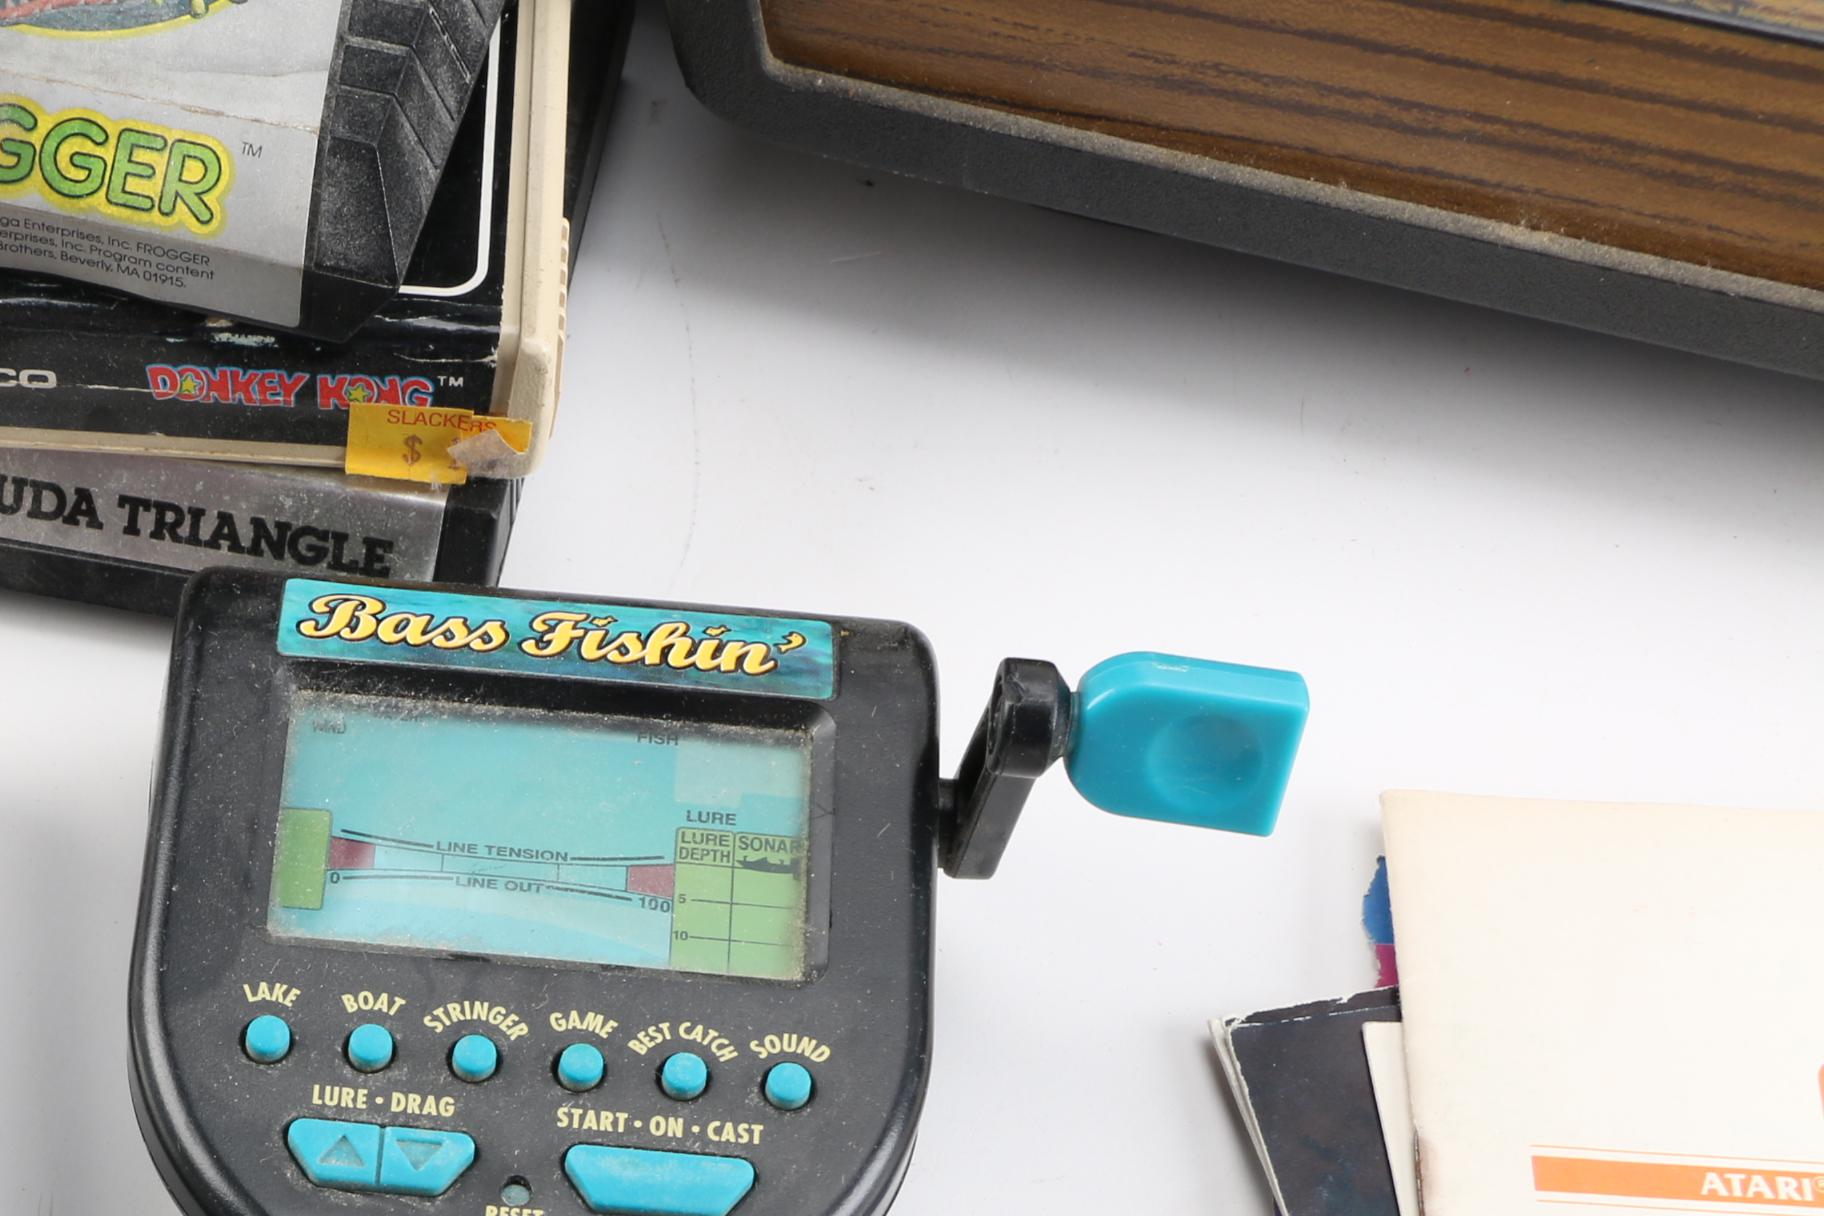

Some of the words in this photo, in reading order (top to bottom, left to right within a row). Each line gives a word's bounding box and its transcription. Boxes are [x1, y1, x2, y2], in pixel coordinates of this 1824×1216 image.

[89, 245, 152, 267] Program
[155, 261, 214, 280] content
[136, 243, 211, 266] FROGGER
[117, 263, 140, 278] MA
[145, 364, 310, 408] DONKEY
[318, 374, 435, 409] KONG
[387, 410, 497, 432] SLACKERS
[117, 494, 393, 577] TRIANGLE
[297, 594, 510, 653] Bass
[520, 611, 808, 677] Fishin'
[686, 810, 737, 826] LURE
[436, 841, 478, 855] LINE
[486, 845, 569, 862] TENSION
[681, 831, 730, 847] LURE
[679, 847, 730, 863] DEPTH
[455, 875, 499, 890] LINE
[504, 880, 544, 894] OUT
[638, 897, 671, 913] 100
[243, 982, 302, 1007] LAKE
[341, 992, 407, 1015] BOAT
[423, 1001, 530, 1041] STRINGER
[549, 1011, 619, 1039] GAME
[628, 1021, 673, 1056] BEST
[678, 1021, 739, 1062] CATCH
[750, 1035, 831, 1064] SOUND
[312, 1084, 368, 1109] LURE
[391, 1092, 456, 1117] DRAG
[557, 1107, 628, 1134] START
[650, 1118, 685, 1138] ON
[707, 1120, 765, 1145] CAST
